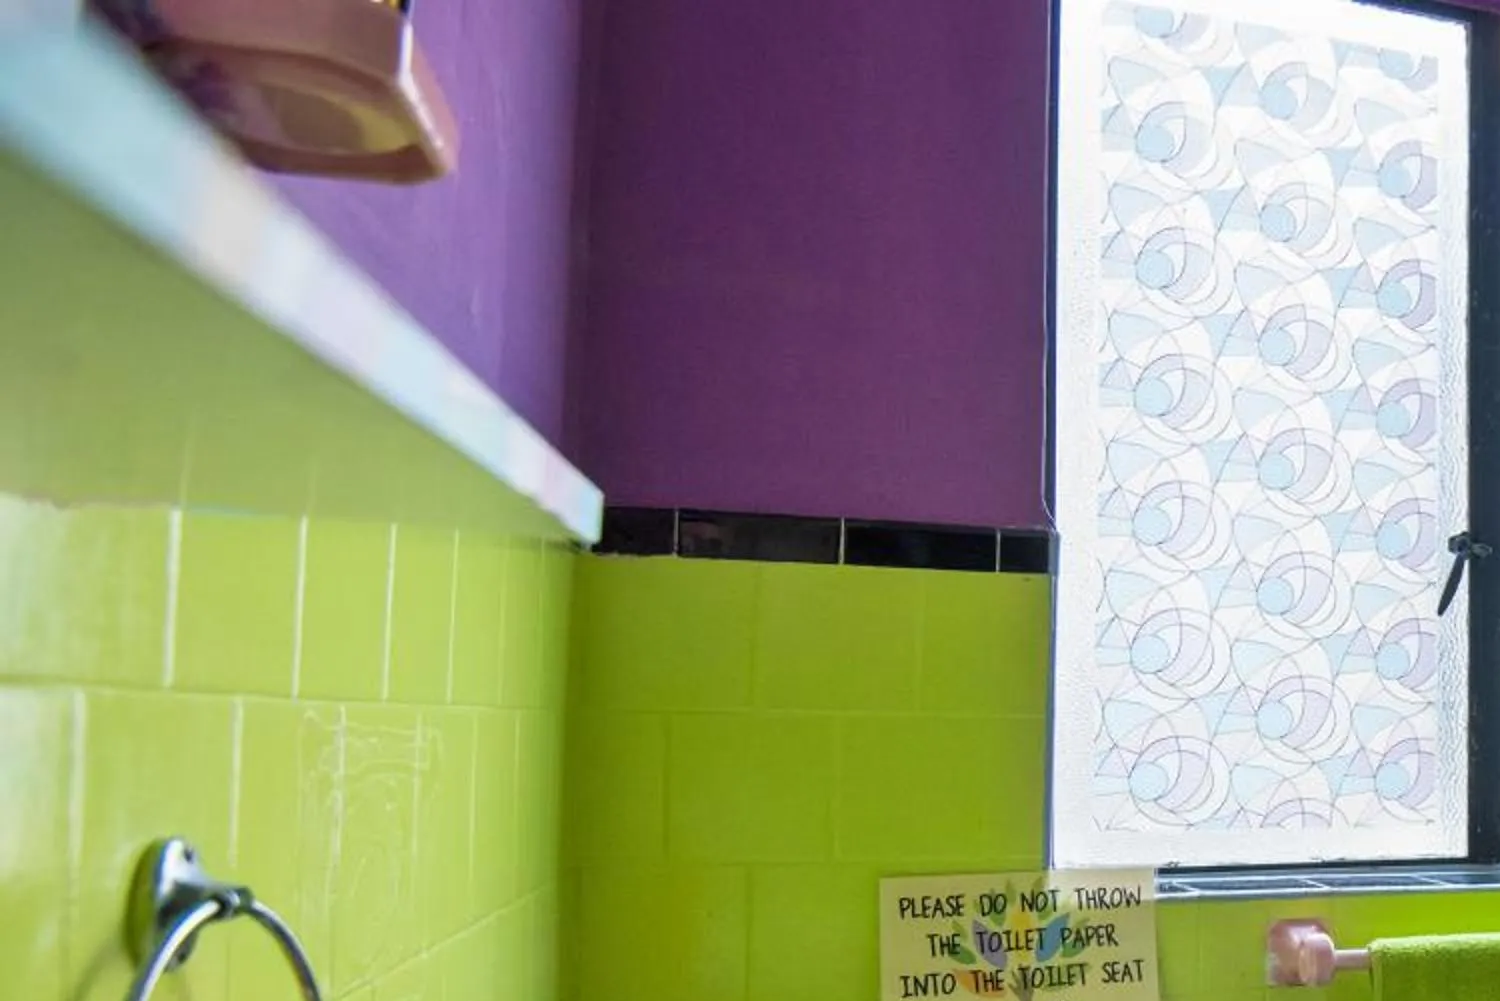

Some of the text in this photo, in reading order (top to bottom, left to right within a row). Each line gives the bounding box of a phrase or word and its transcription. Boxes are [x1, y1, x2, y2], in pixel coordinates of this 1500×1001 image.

[899, 884, 1142, 920] PLEASE DO NOT THROW
[927, 923, 1119, 958] THE TOILET PAPER
[900, 959, 1144, 999] INTO THE TOILET SEAT
